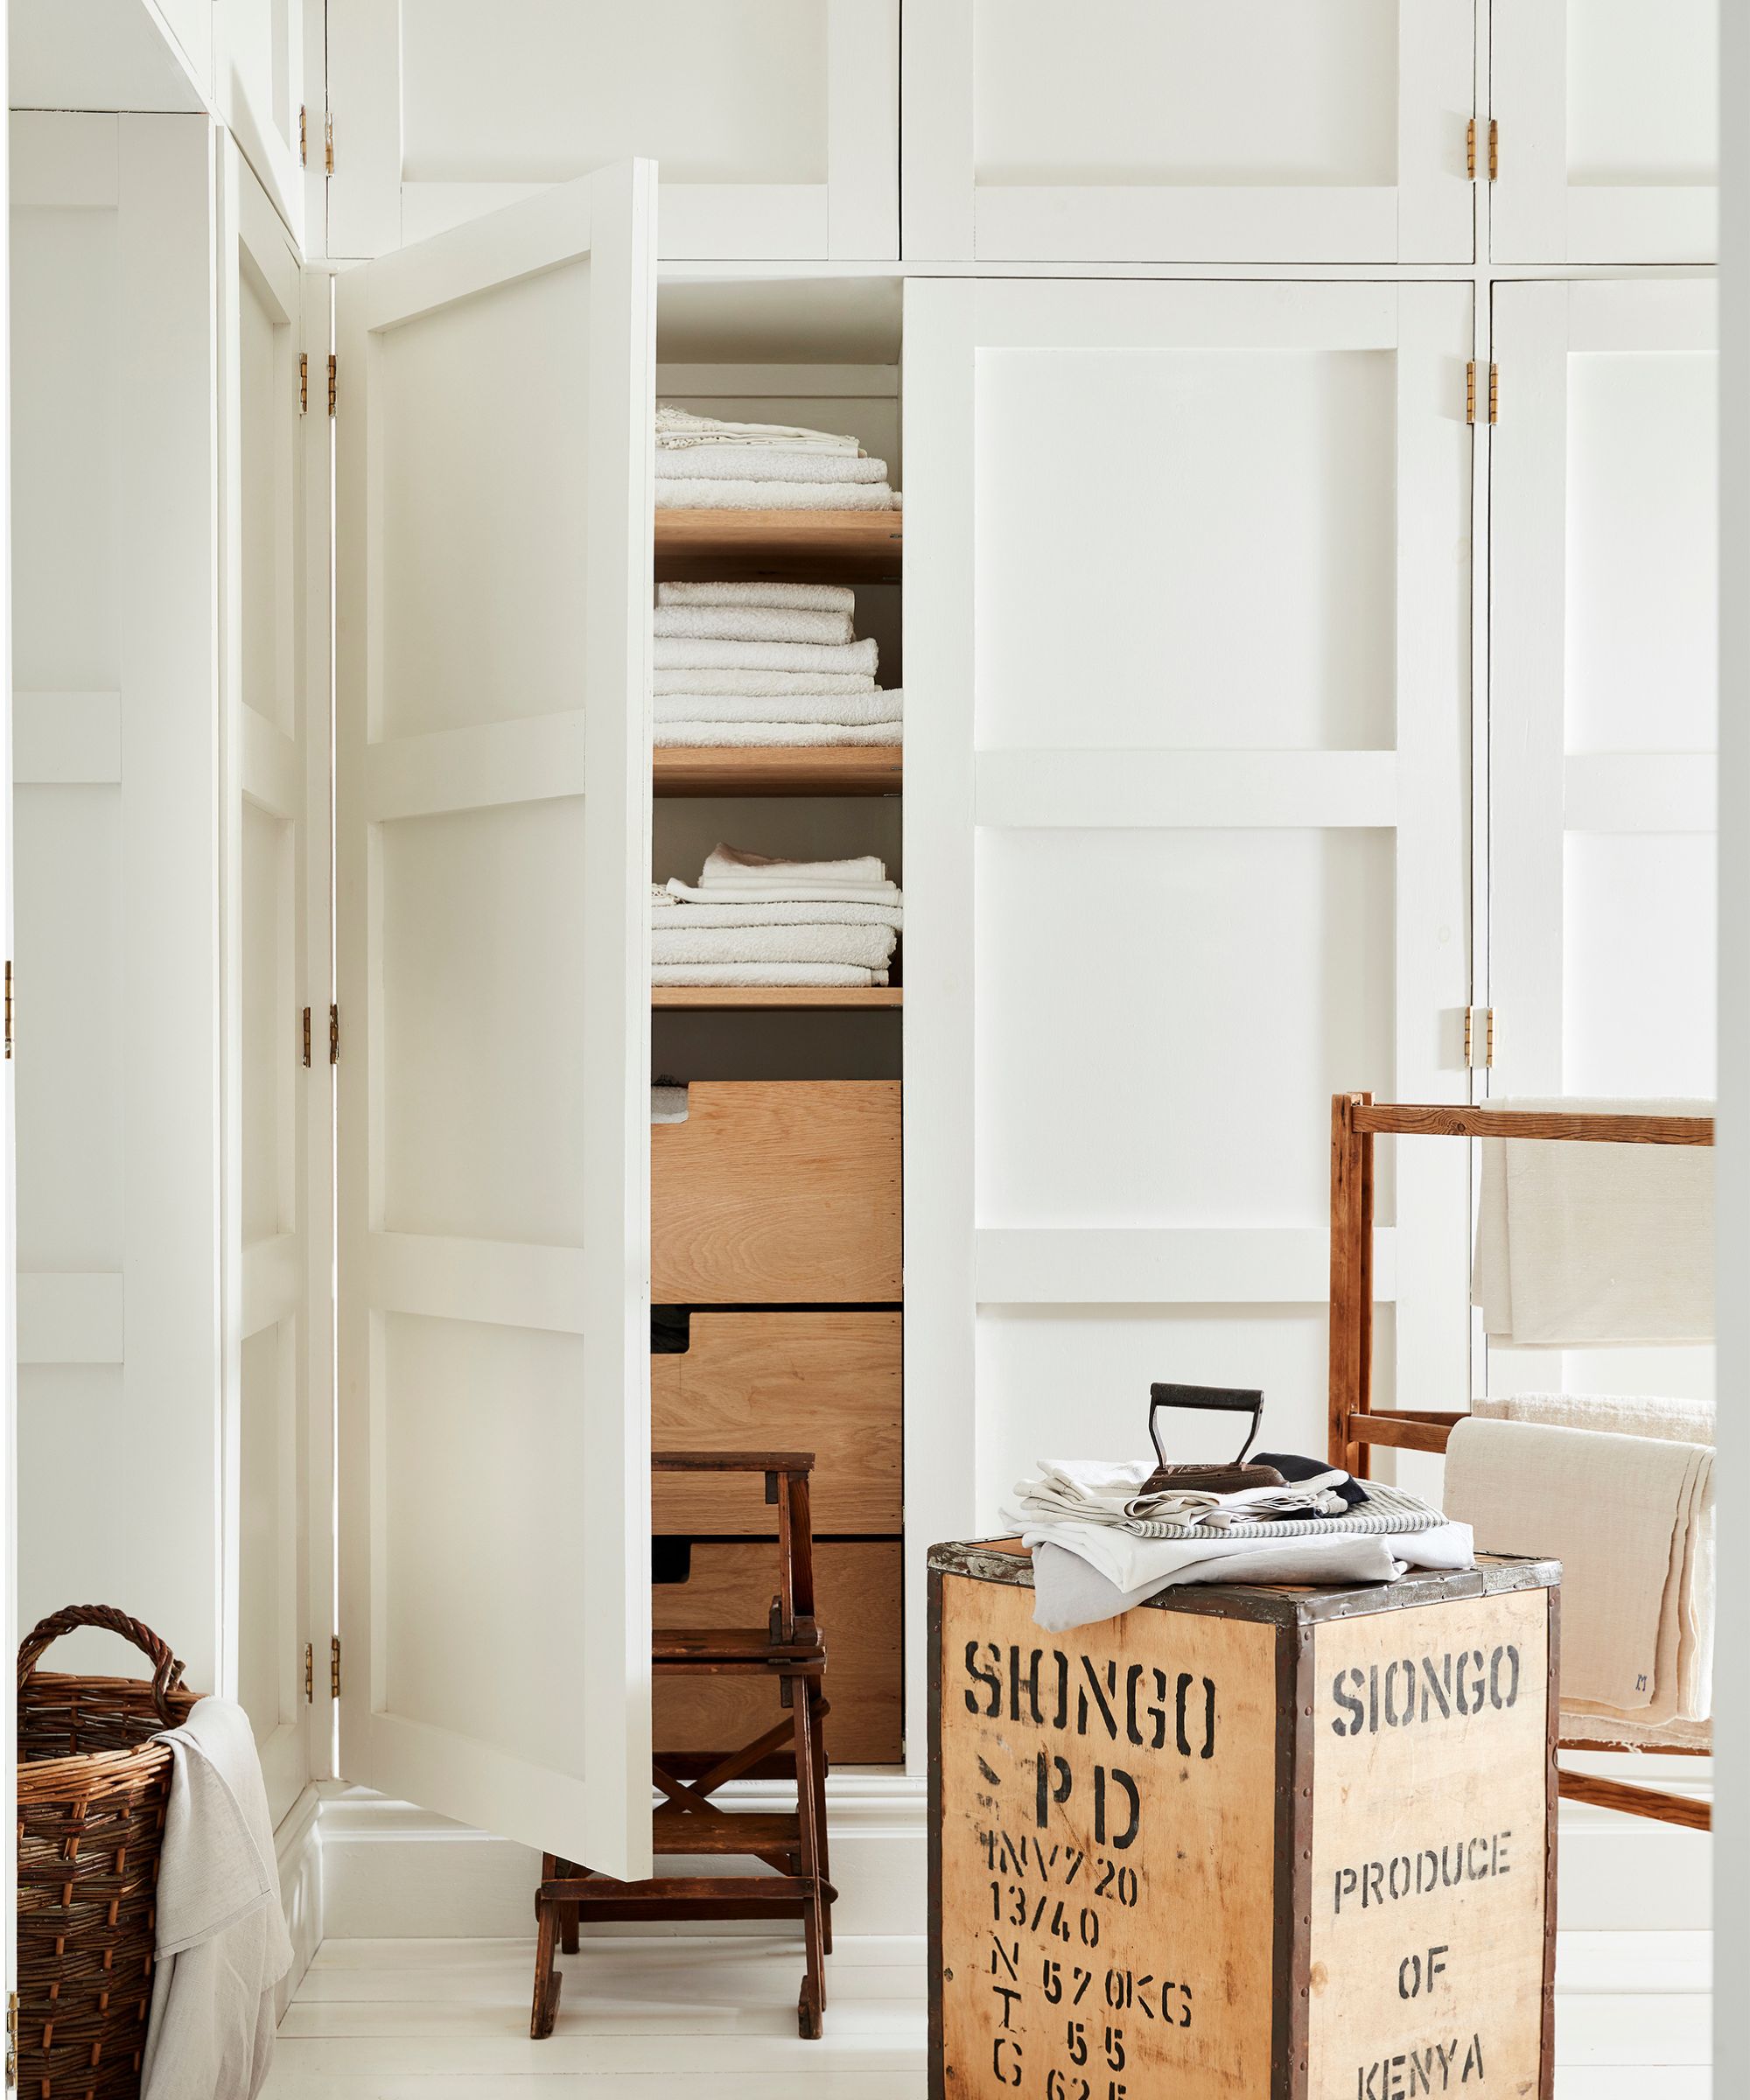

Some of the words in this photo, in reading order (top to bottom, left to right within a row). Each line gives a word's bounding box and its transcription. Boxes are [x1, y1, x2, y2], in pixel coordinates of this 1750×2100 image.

[1332, 1645, 1519, 1737] SIONGO
[1334, 1831, 1511, 1914] PRODUCE
[990, 1881, 1099, 1949] 13/40
[1398, 1945, 1449, 1999] OF
[992, 1985, 1022, 2028] T
[1358, 2033, 1484, 2100] KENYA
